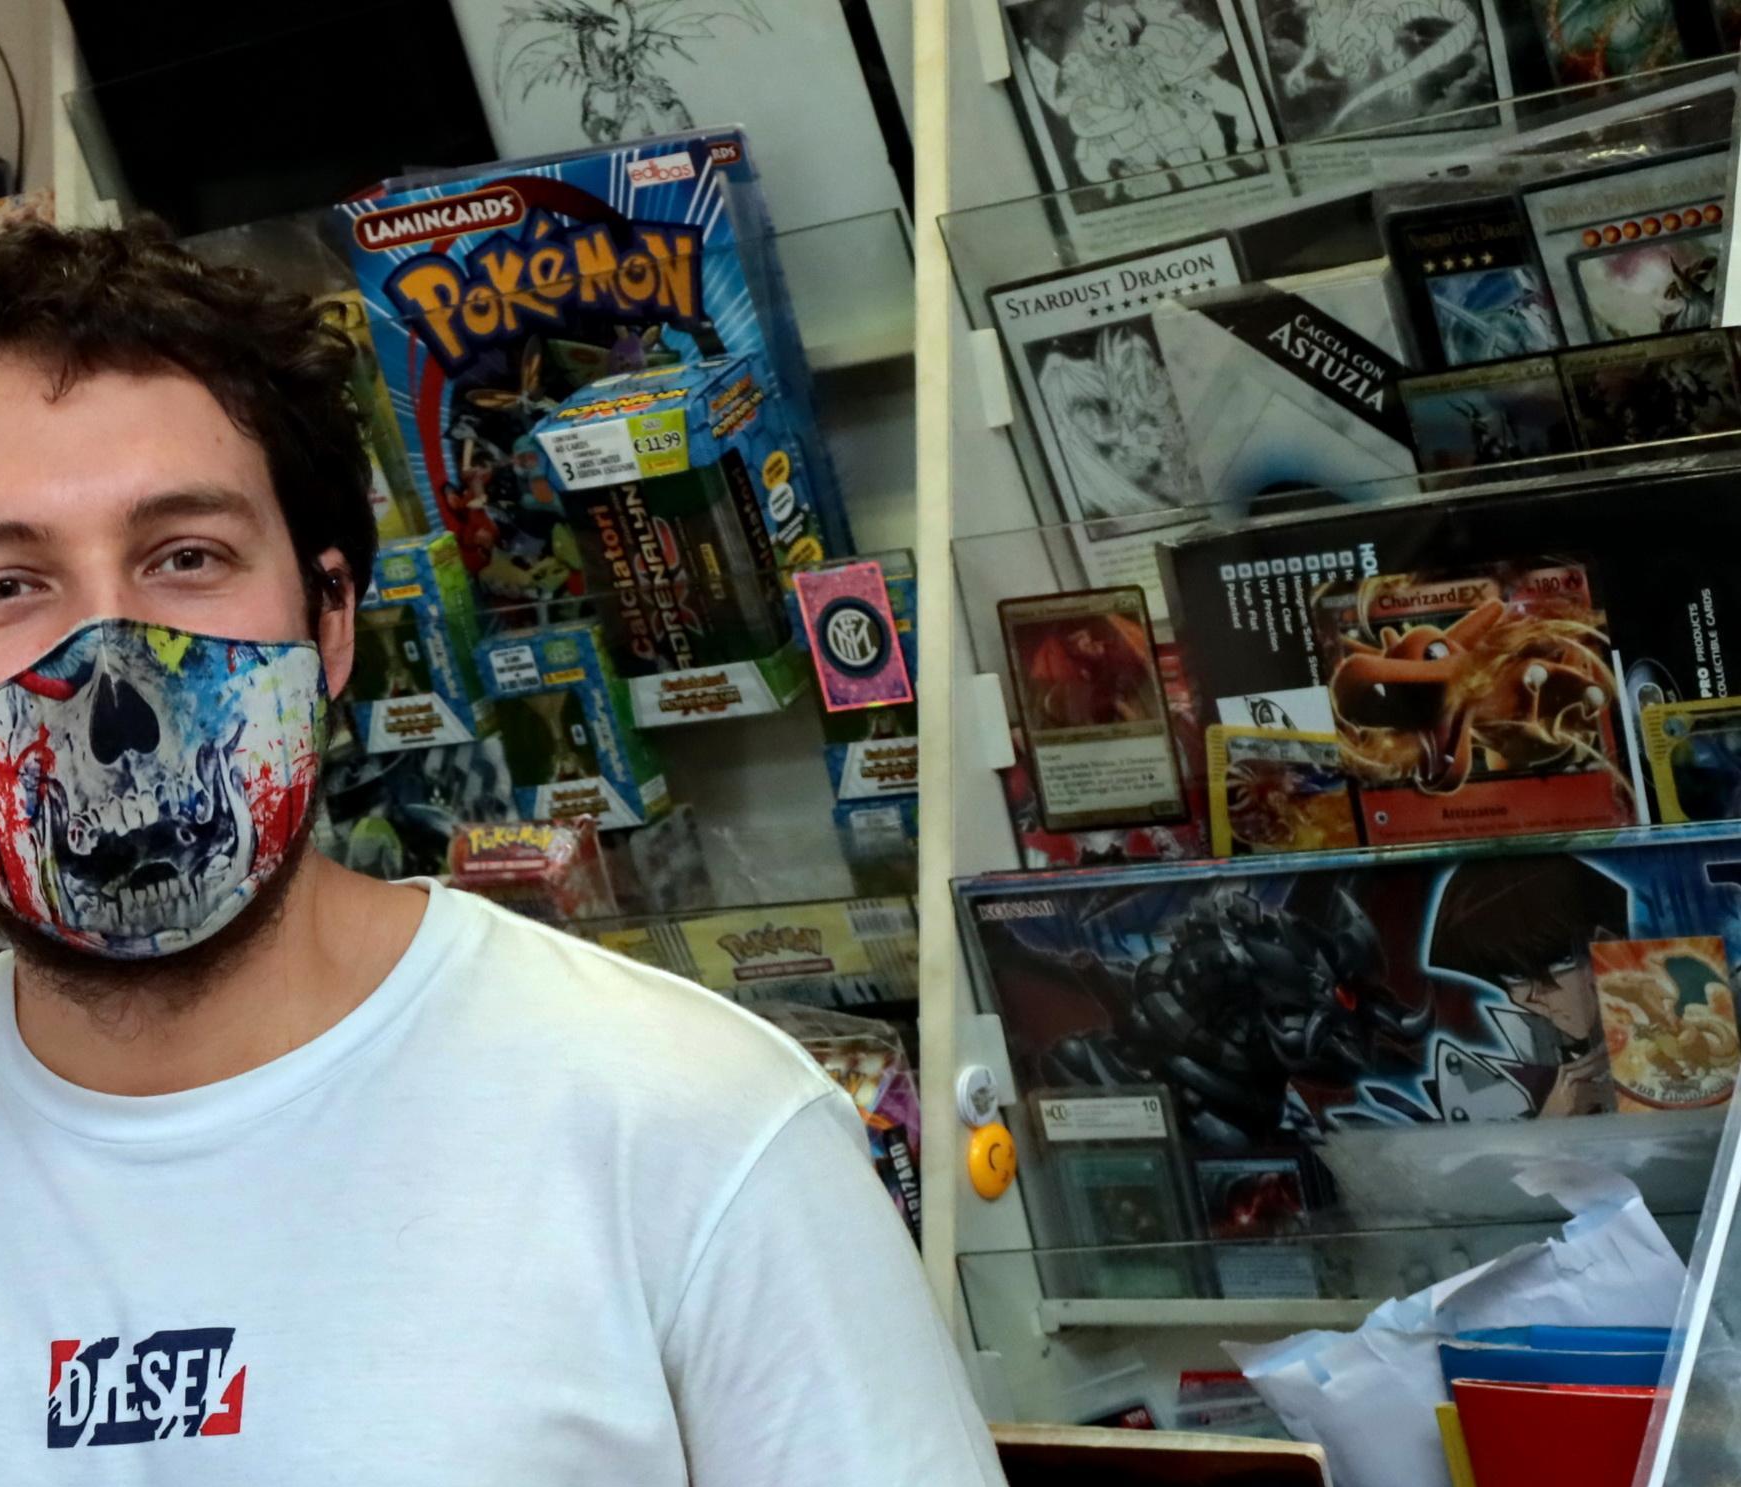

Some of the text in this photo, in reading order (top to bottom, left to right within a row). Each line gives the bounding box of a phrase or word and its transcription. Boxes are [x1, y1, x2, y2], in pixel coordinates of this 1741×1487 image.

[364, 197, 514, 245] LAMINCARDS
[1006, 253, 1214, 320] STARDUST DRAGON
[1268, 322, 1383, 412] ASTUZIA
[1295, 314, 1385, 379] CACCIA CON
[563, 463, 575, 481] 3
[646, 432, 681, 452] 11,99
[1379, 588, 1457, 610] Charizard
[1688, 602, 1712, 699] PRO PRODUCTS
[1702, 588, 1729, 699] COLLECTIBLE CARDS
[978, 900, 1054, 920] KONAMI
[51, 1345, 238, 1432] DIESEL
